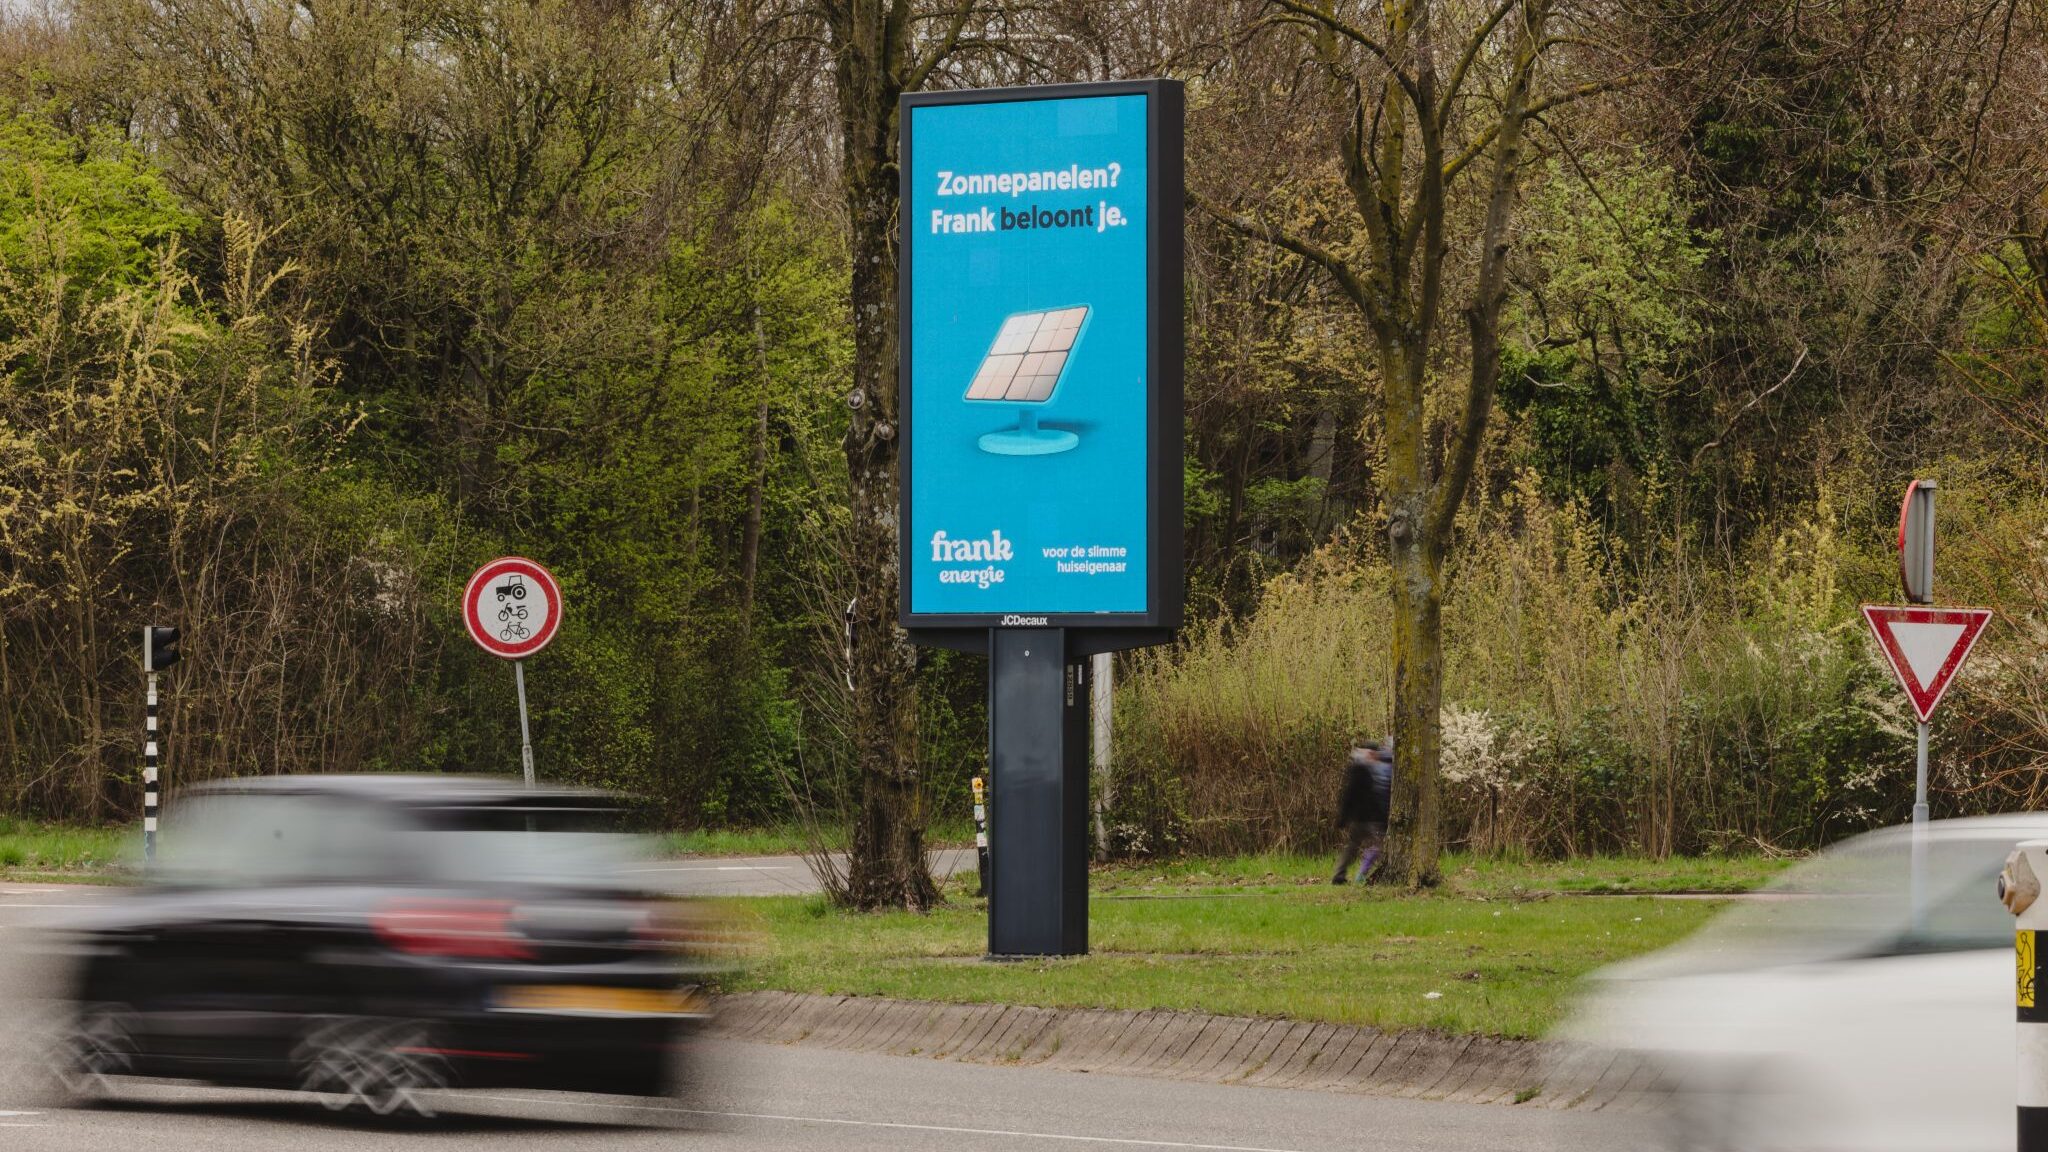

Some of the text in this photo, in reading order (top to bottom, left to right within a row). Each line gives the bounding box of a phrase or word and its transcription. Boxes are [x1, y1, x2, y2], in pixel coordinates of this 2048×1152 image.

[937, 162, 1121, 198] Zonnepanelen?
[931, 201, 1127, 234] Frank beloont je.
[930, 529, 1014, 562] frank
[1042, 545, 1127, 558] voor de slimme
[939, 565, 1005, 589] energie
[1057, 560, 1127, 575] huiseigenaar
[1000, 614, 1048, 626] JCDecaux
